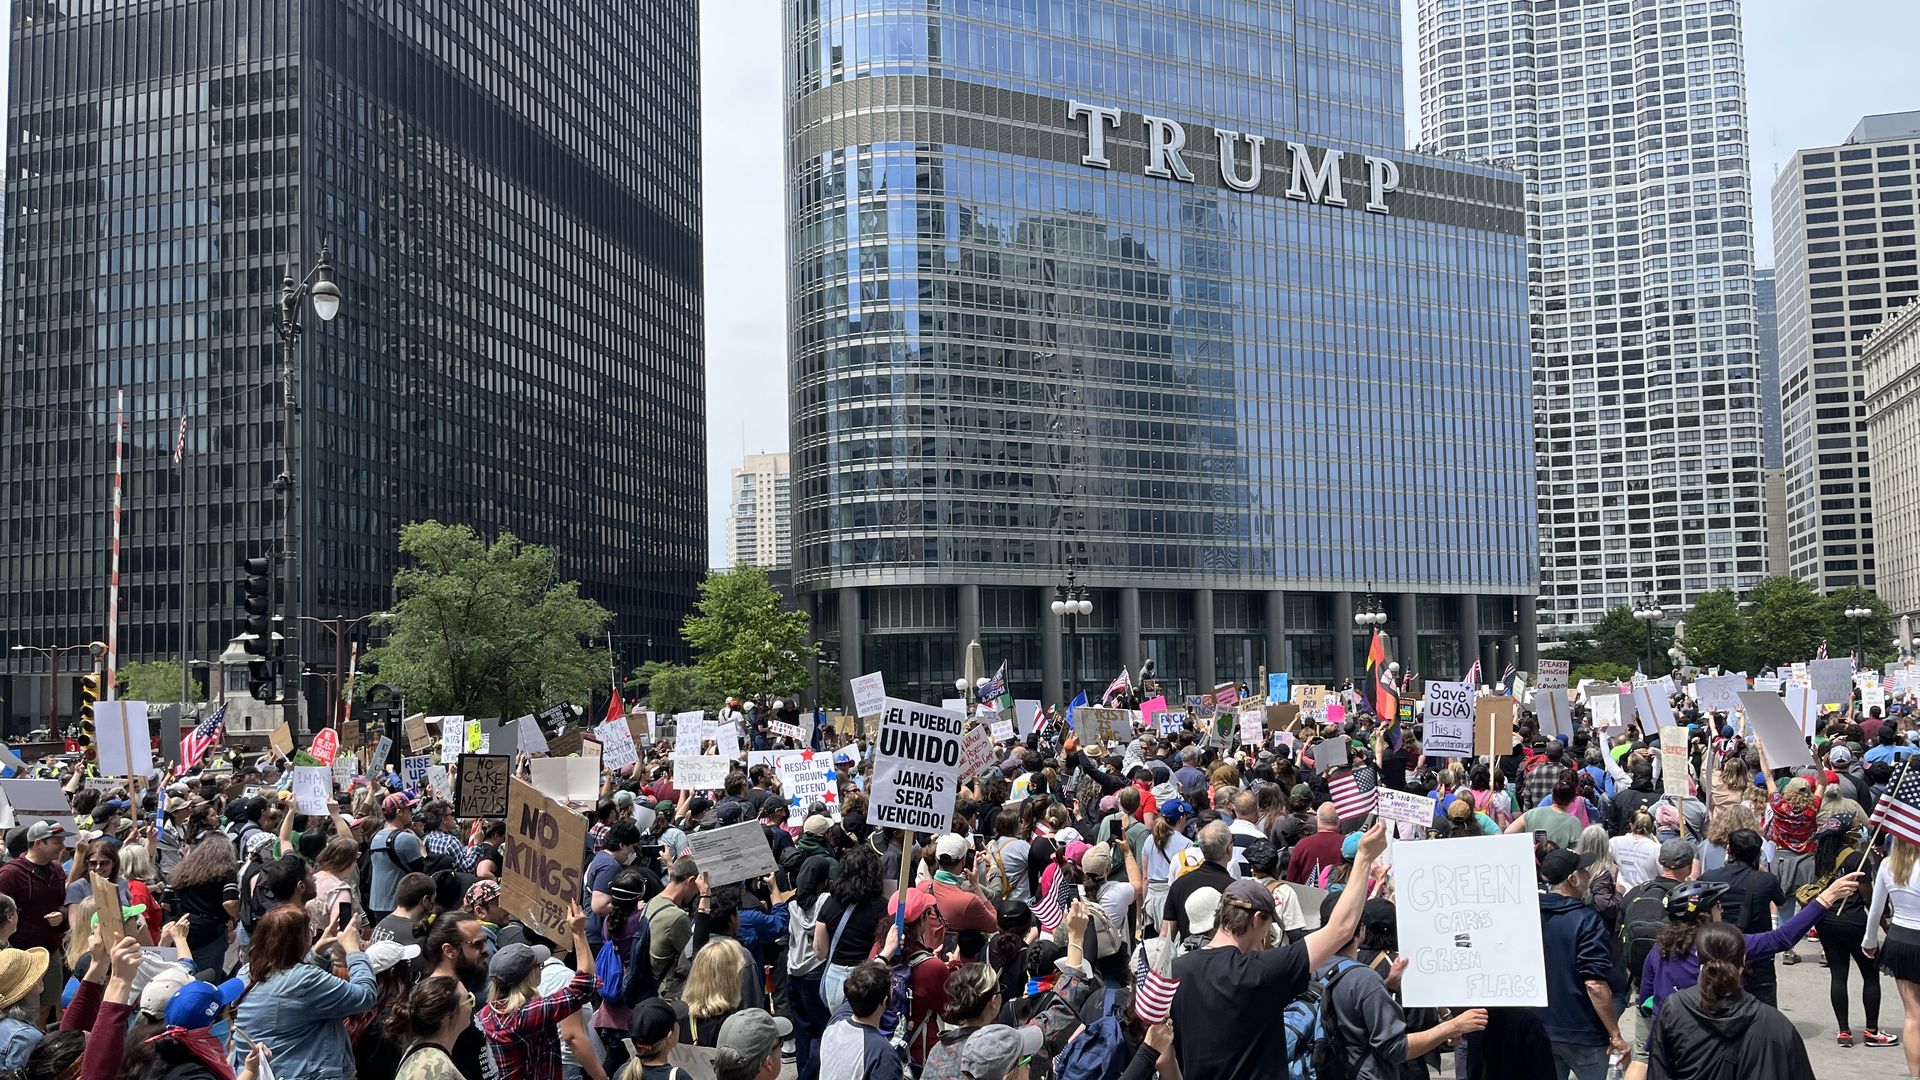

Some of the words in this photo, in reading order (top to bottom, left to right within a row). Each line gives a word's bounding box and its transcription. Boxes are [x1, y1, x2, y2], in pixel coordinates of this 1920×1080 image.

[1068, 100, 1399, 214] TRUMP
[1188, 697, 1201, 705] NO
[1430, 683, 1466, 703] Save
[1303, 700, 1317, 708] RICH
[1430, 702, 1470, 718] US(A)
[884, 707, 905, 725] ¡EL
[910, 711, 961, 735] PUEBLO
[1428, 720, 1448, 735] This
[1453, 724, 1462, 736] is
[880, 728, 959, 766] UNIDO
[405, 758, 430, 768] RISE
[478, 757, 493, 770] NO
[784, 761, 812, 772] RESIST
[816, 759, 830, 768] THE
[409, 770, 426, 780] UP
[464, 770, 506, 785] CAKE
[795, 771, 823, 782] CROWN
[893, 770, 944, 792] JAMÁS
[473, 785, 498, 795] FOR
[795, 783, 826, 794] DEFEND
[461, 796, 504, 814] NAZIS
[804, 794, 819, 804] THE
[895, 789, 933, 809] SERÁ
[520, 803, 559, 849] NO
[877, 805, 945, 829] VENCIDO!
[505, 835, 579, 903] KINGS
[1408, 864, 1521, 912] GREEN
[540, 908, 568, 935] 1776
[1416, 947, 1482, 974] GREEN
[1466, 972, 1539, 999] FLAGS
